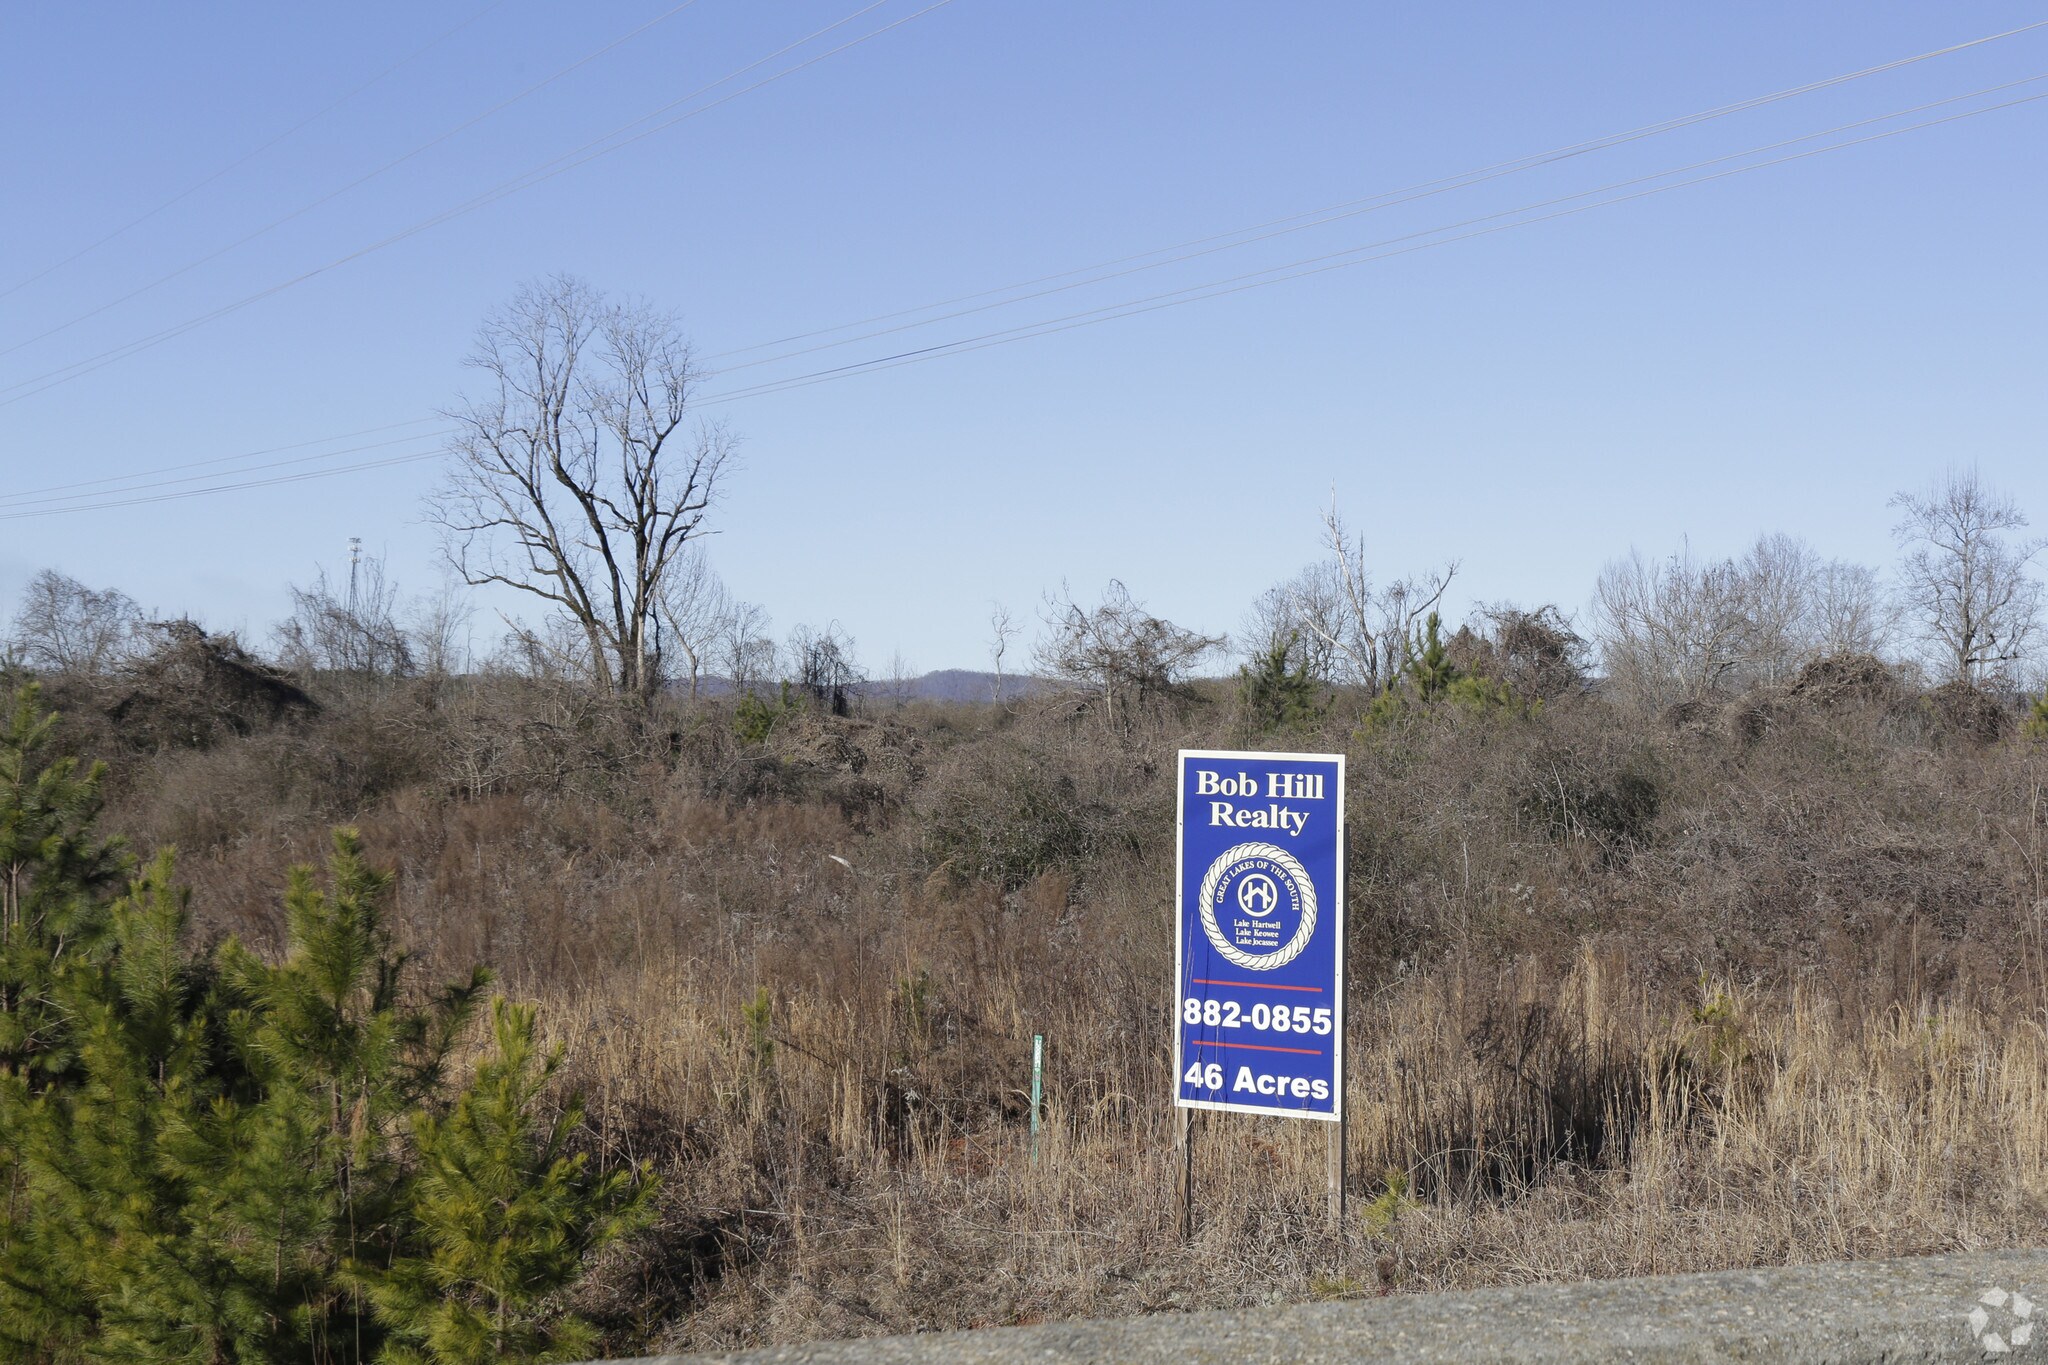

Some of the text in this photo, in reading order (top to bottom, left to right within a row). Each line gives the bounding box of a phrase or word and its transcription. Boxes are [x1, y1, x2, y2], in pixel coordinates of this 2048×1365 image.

[1196, 770, 1324, 800] Bob Hill
[1209, 801, 1310, 836] Realty
[1216, 861, 1299, 910] GREAT LAKES OF THE SOUTH
[1234, 919, 1281, 929] Lake Hartwell
[1236, 928, 1279, 938] Lake Keowee
[1252, 938, 1278, 946] Jocassee
[1183, 998, 1332, 1035] 882-0855
[1184, 1062, 1329, 1100] 46 Acres
